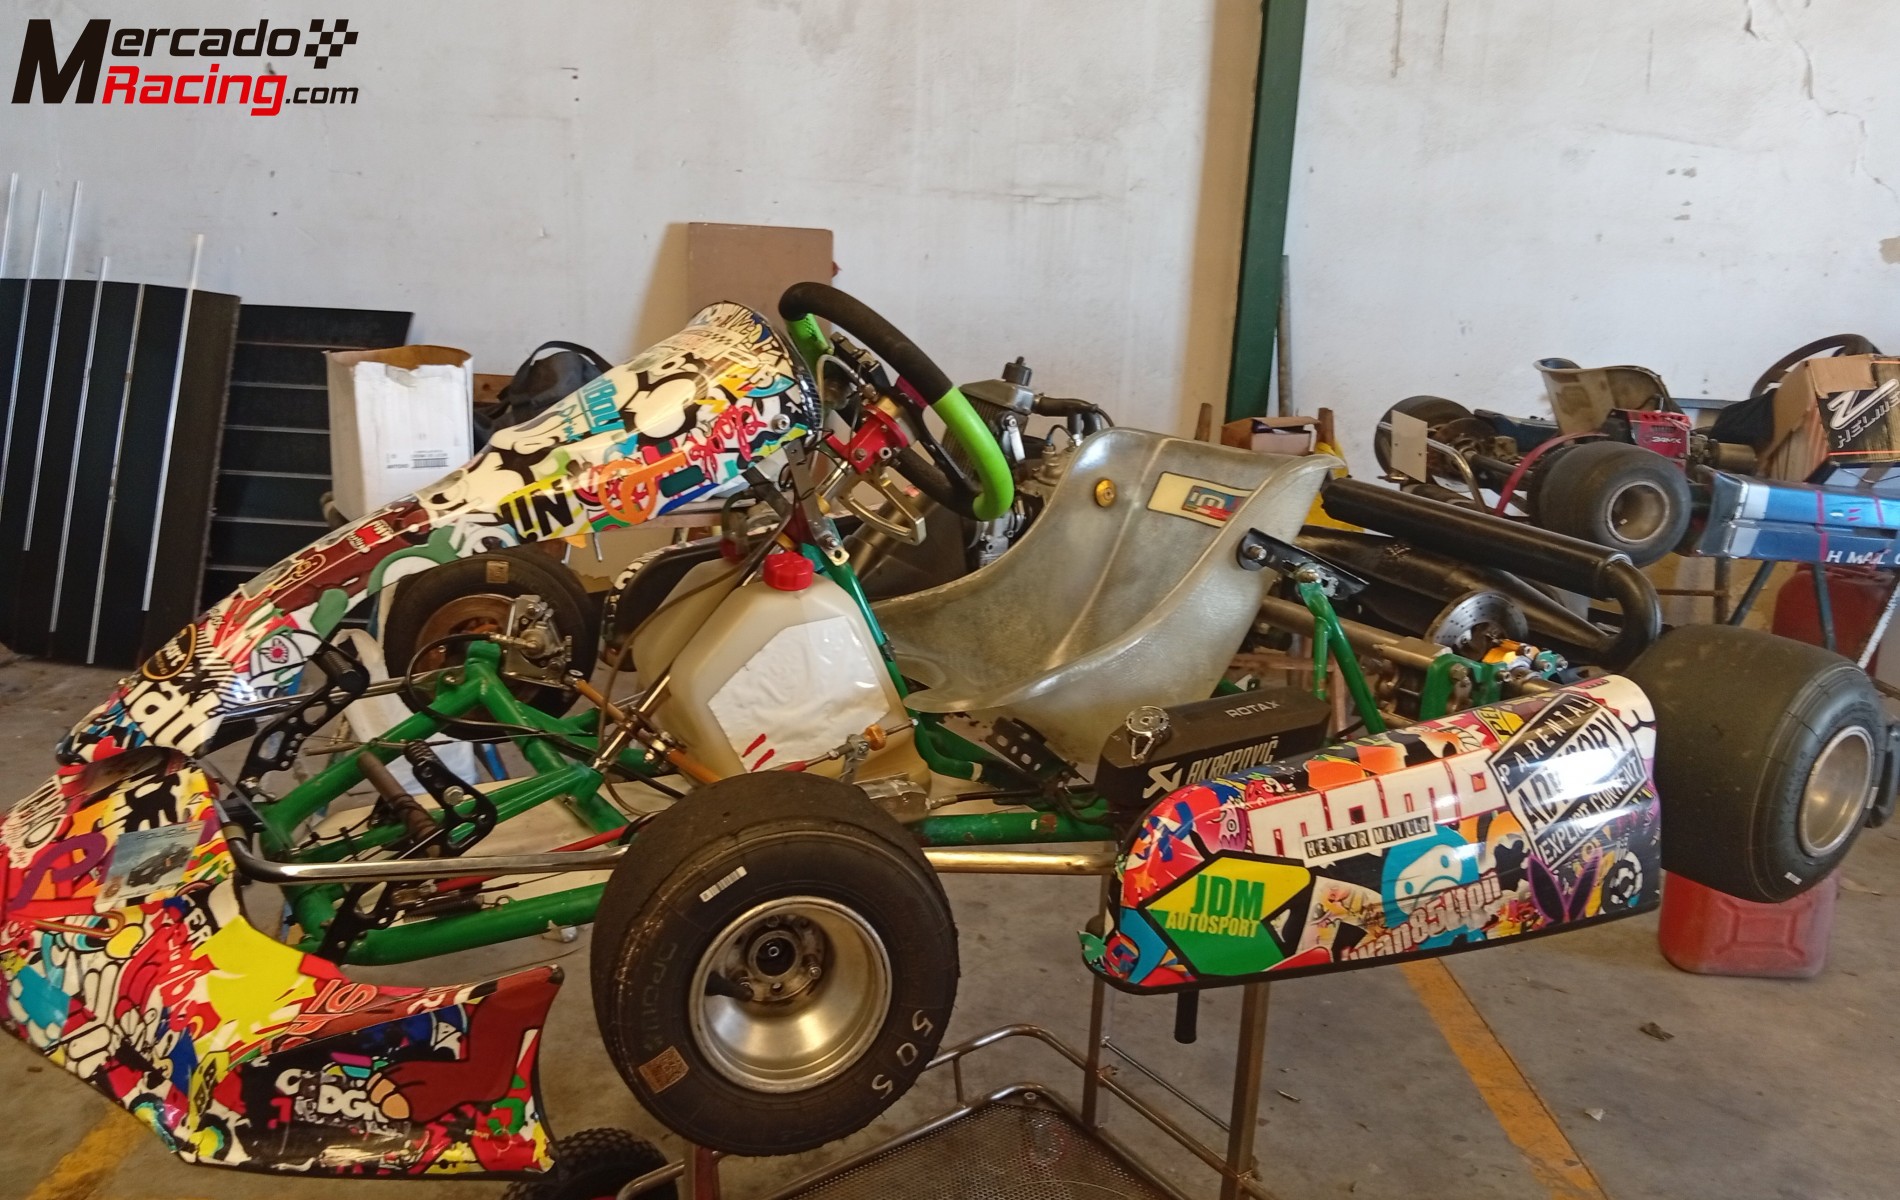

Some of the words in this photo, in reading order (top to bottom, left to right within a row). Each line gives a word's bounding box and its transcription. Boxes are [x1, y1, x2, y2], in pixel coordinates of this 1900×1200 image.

[1224, 700, 1281, 719] ROTAX
[1497, 696, 1594, 786] PARENTAL
[1305, 830, 1370, 858] HECTOR
[1374, 816, 1430, 844] MAILLO
[1190, 873, 1265, 921] JDM
[1165, 910, 1261, 939] AUTOSPORT
